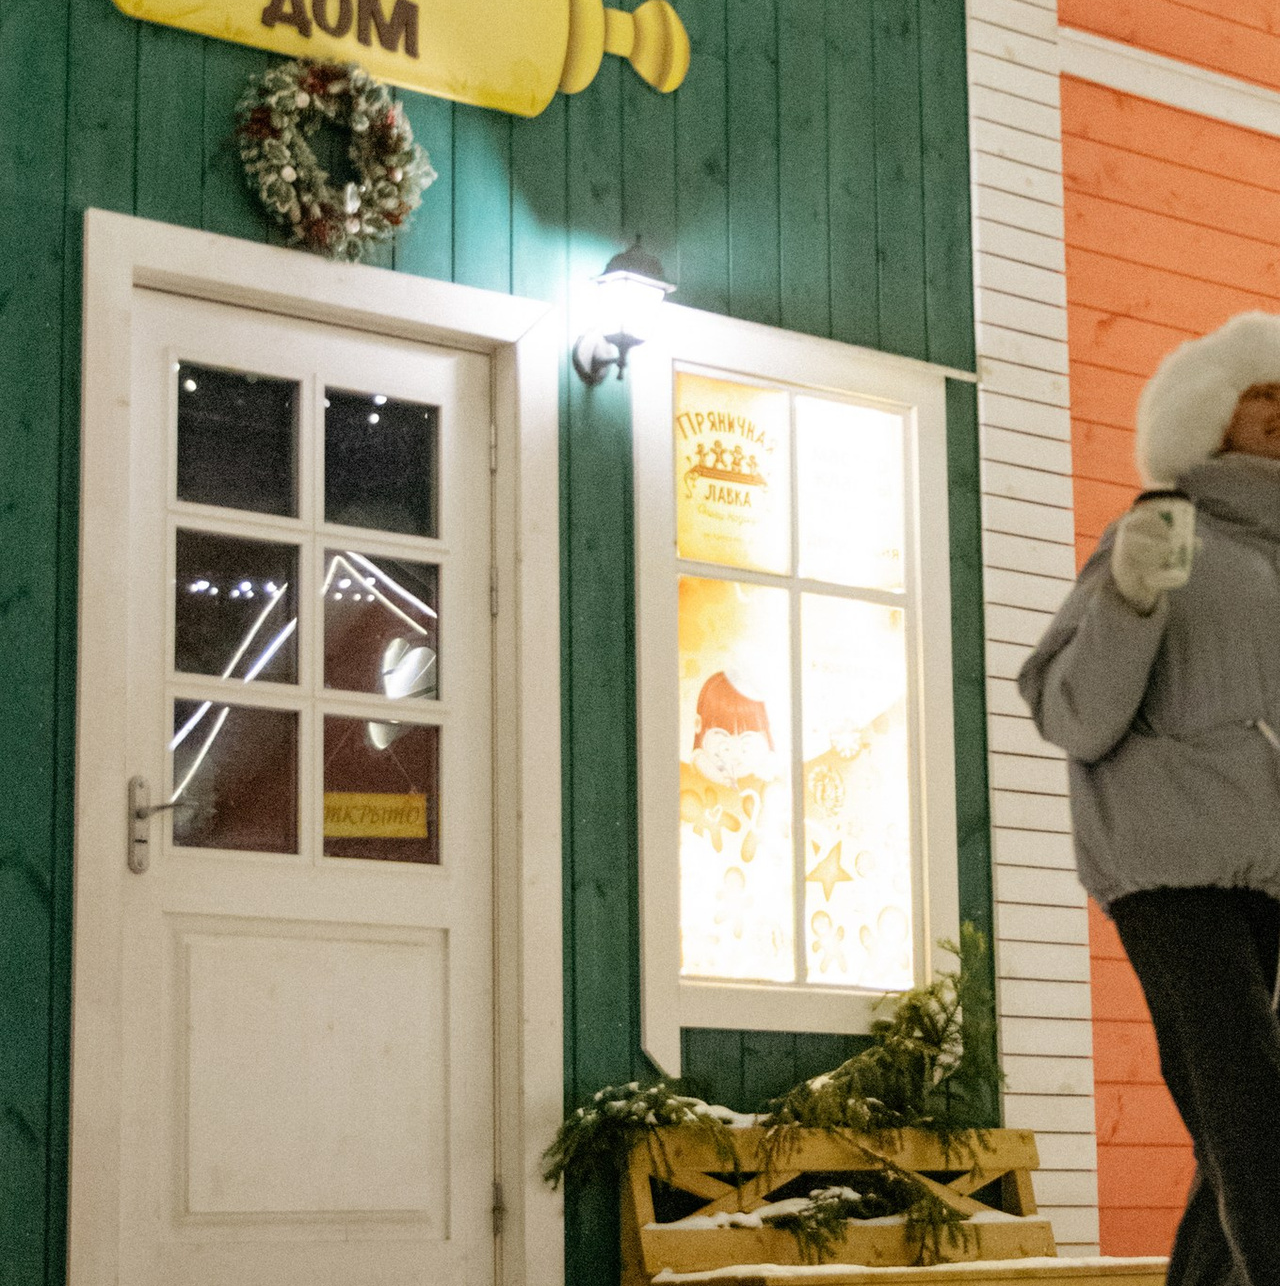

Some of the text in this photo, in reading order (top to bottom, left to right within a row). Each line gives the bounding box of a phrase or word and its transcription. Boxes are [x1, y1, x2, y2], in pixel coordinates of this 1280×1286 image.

[676, 411, 778, 454] ПРЯНИЧНАЯ
[704, 484, 752, 508] ЛАВКА
[324, 805, 421, 825] ТКРЫТО
